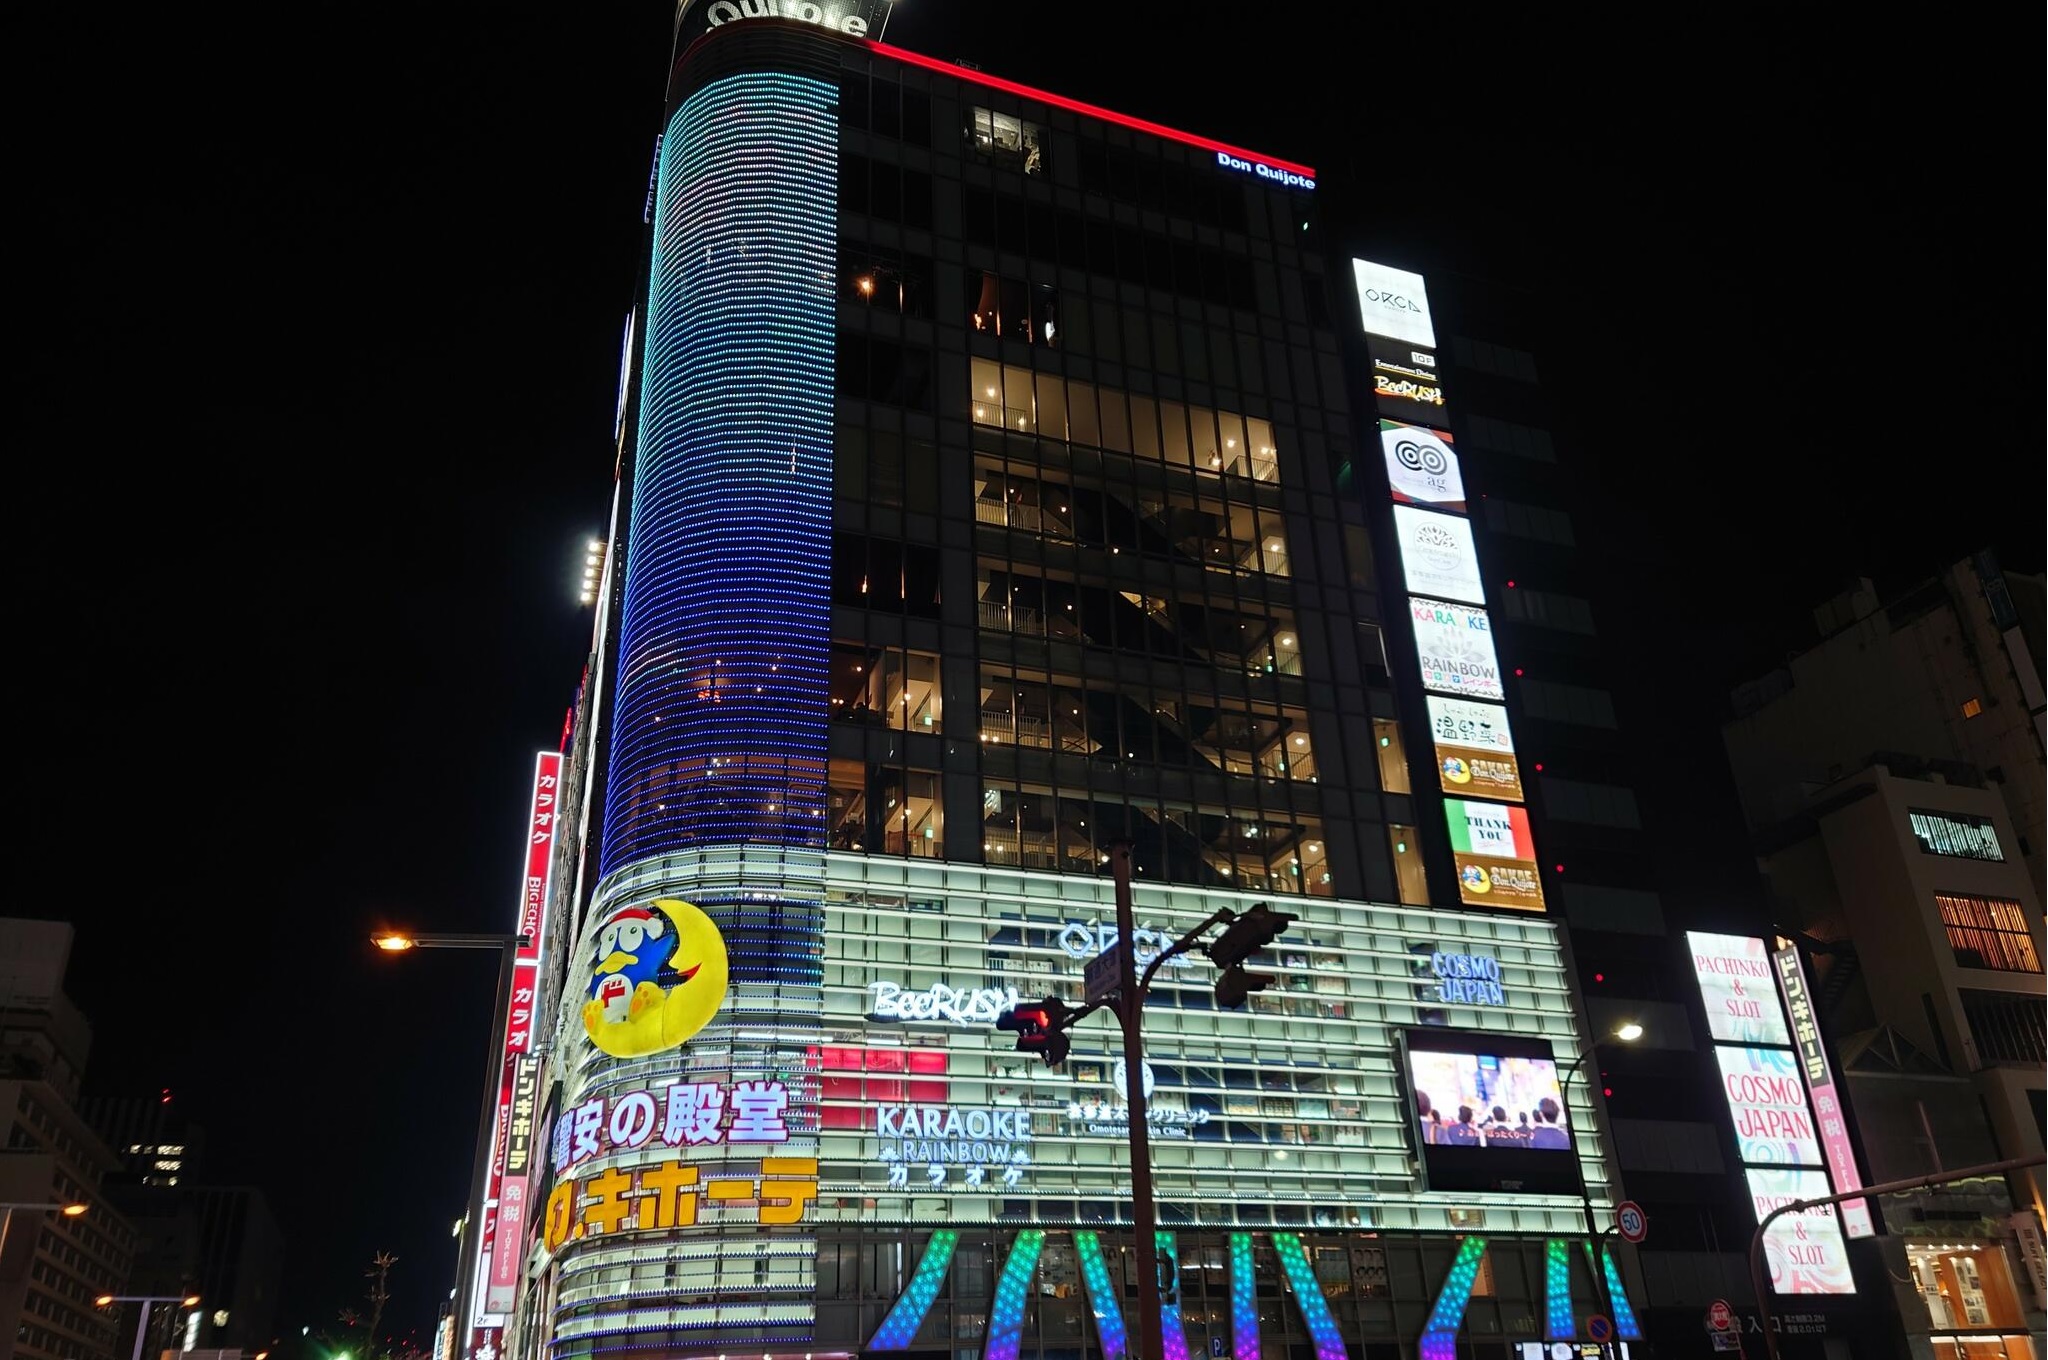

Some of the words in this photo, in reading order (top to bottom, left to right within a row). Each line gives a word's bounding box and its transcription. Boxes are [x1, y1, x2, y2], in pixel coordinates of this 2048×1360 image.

[1218, 152, 1252, 172] Don
[1256, 163, 1316, 189] Quijote
[1365, 288, 1422, 314] ORCA
[1427, 476, 1447, 493] ag
[1422, 656, 1495, 679] RAINBOW
[532, 774, 556, 844] カラオケ
[1464, 816, 1513, 831] THANK
[1479, 829, 1503, 841] YOU
[1433, 952, 1499, 980] COSMO
[1695, 955, 1770, 978] PACHINKO
[1438, 977, 1505, 1004] JAPAN
[1732, 979, 1745, 997] &
[1726, 998, 1762, 1019] SLOT
[1727, 1073, 1802, 1106] COSMO
[878, 1106, 1031, 1141] KARAOKE
[1163, 1126, 1187, 1136] Clinic
[1738, 1108, 1811, 1139] JAPAN
[903, 1141, 1010, 1163] RAINBOW
[888, 1163, 1023, 1186] カラオケ
[503, 1185, 522, 1222] 免税
[1622, 1213, 1640, 1231] 50
[1795, 1220, 1808, 1241] &
[1788, 1245, 1826, 1265] SLOT
